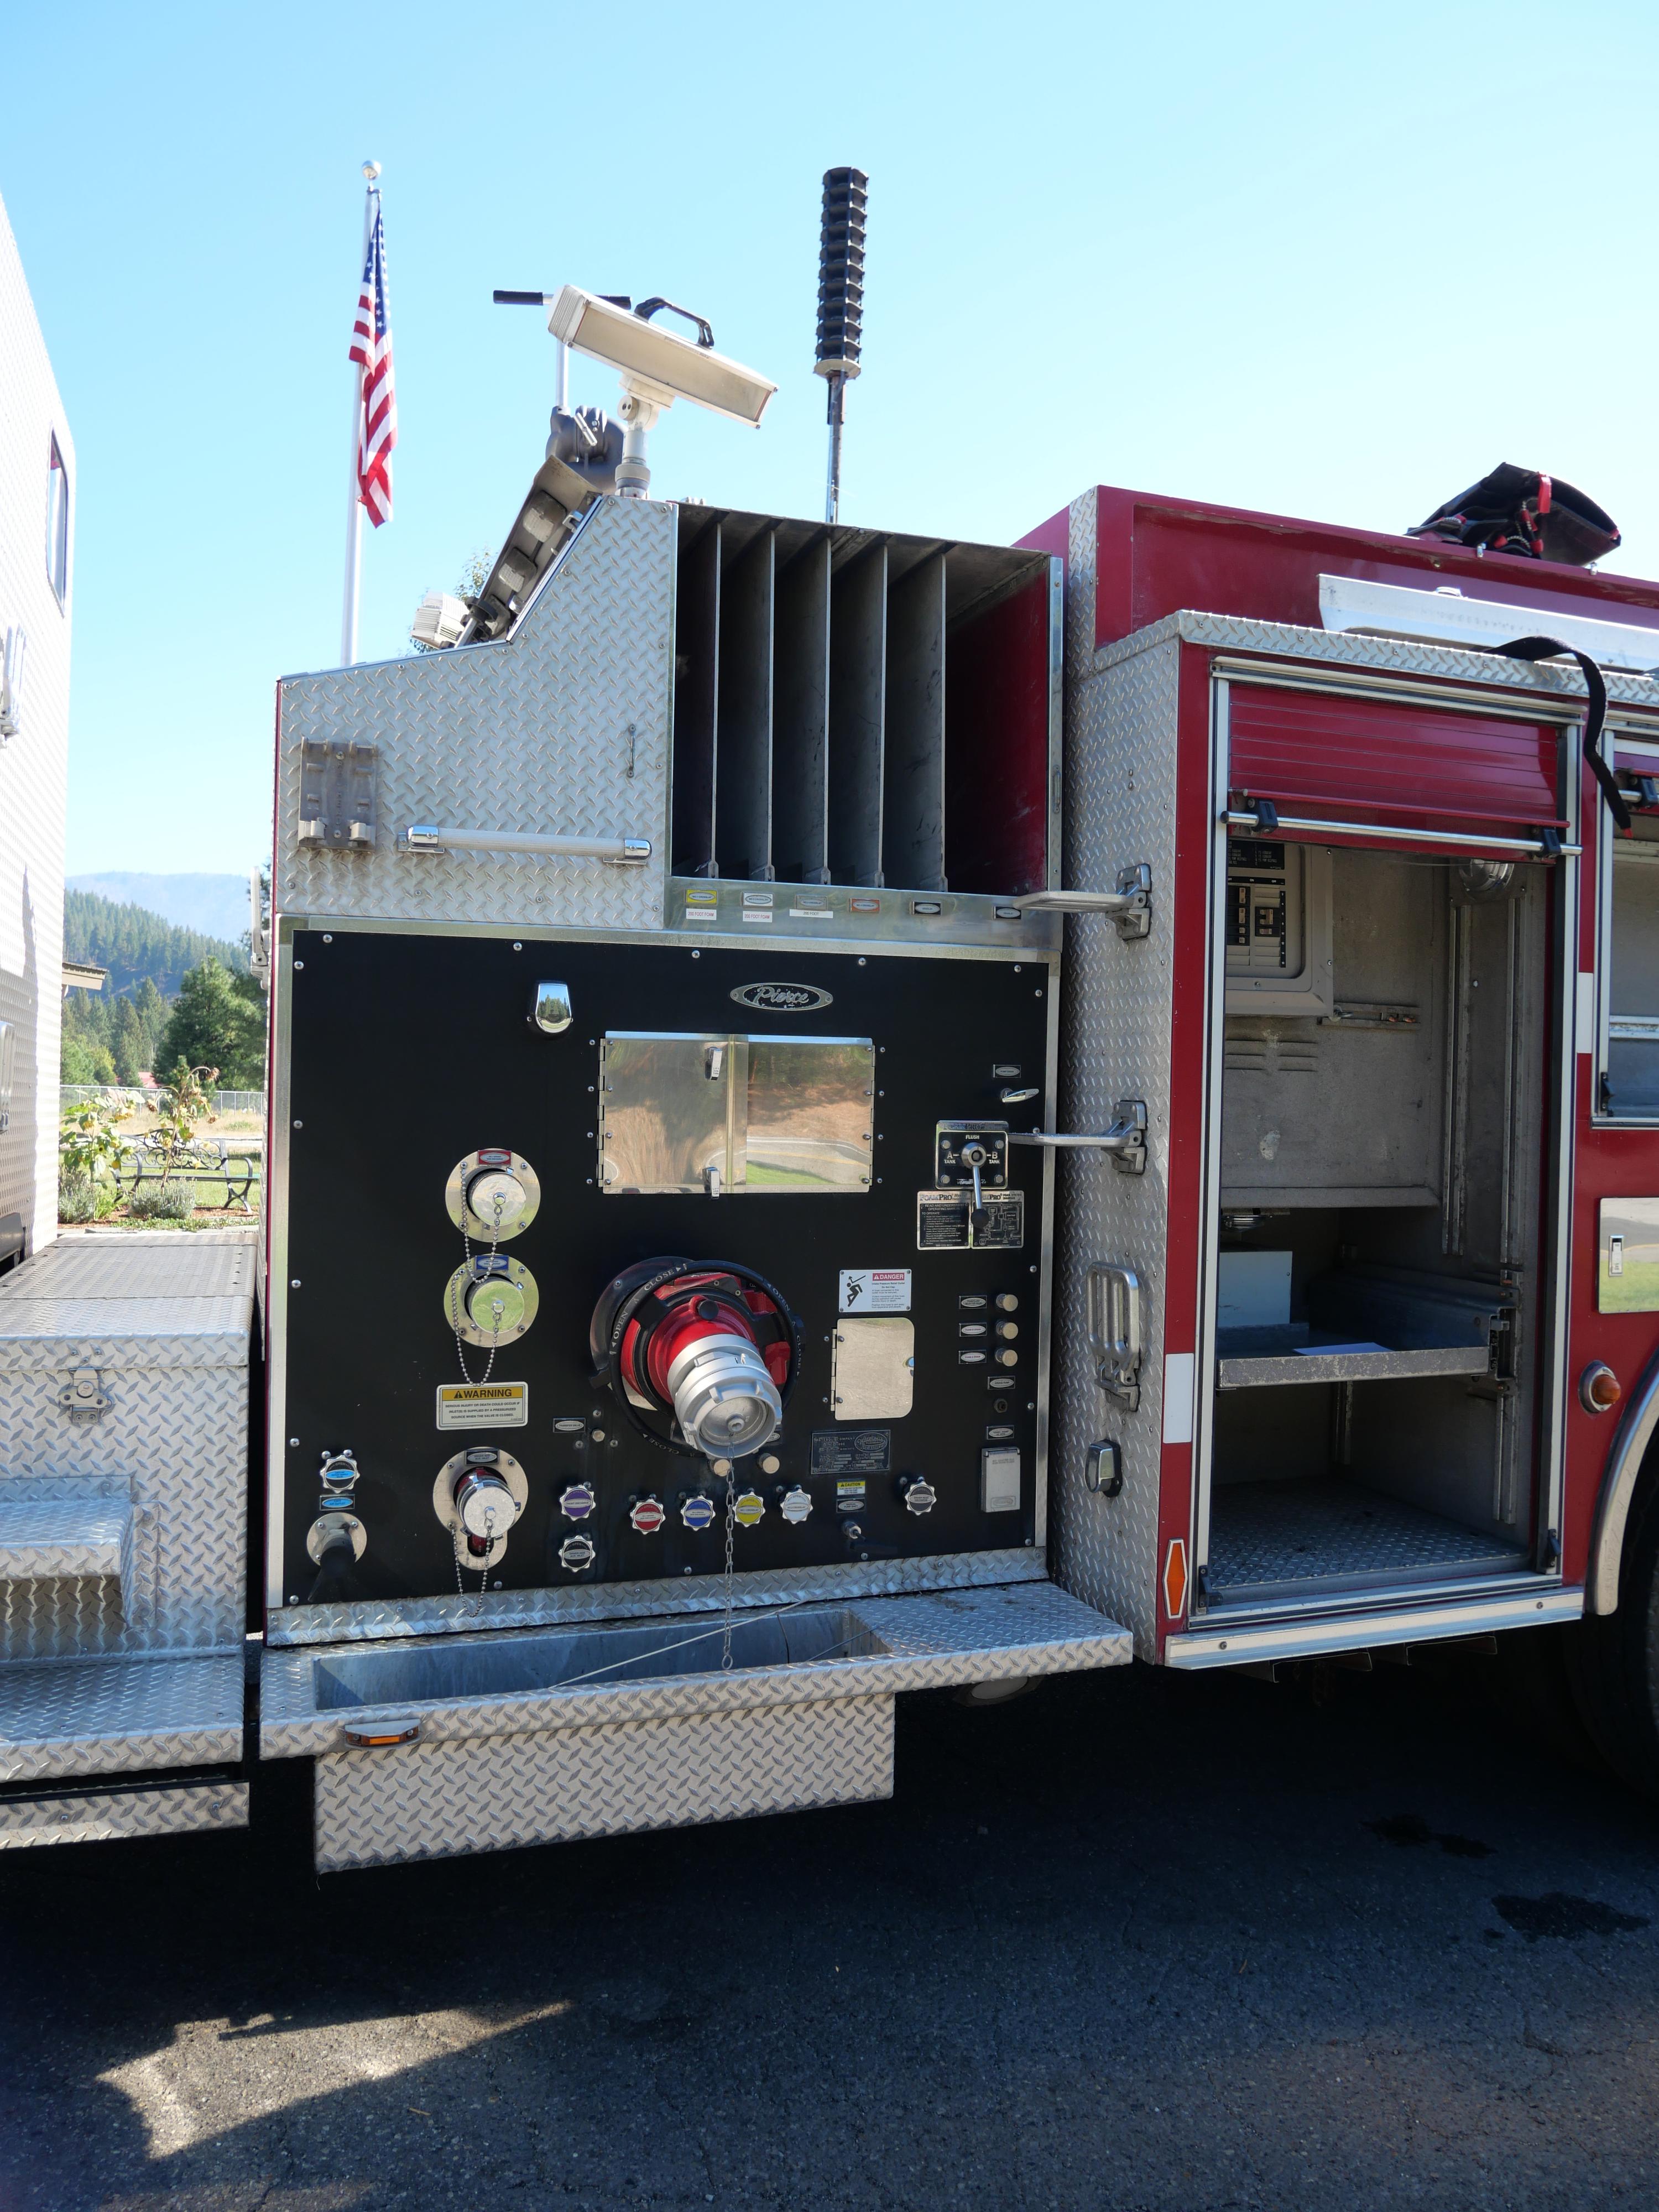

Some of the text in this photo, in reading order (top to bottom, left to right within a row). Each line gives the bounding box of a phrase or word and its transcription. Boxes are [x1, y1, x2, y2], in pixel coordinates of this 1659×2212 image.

[753, 985, 809, 1005] Pierce
[947, 1151, 953, 1159] A
[644, 1269, 675, 1291] CLOSE
[773, 1288, 790, 1312] OPEN
[613, 1312, 628, 1339] OPEN
[463, 1389, 512, 1398] WARNING
[649, 1438, 679, 1454] CLOSE
